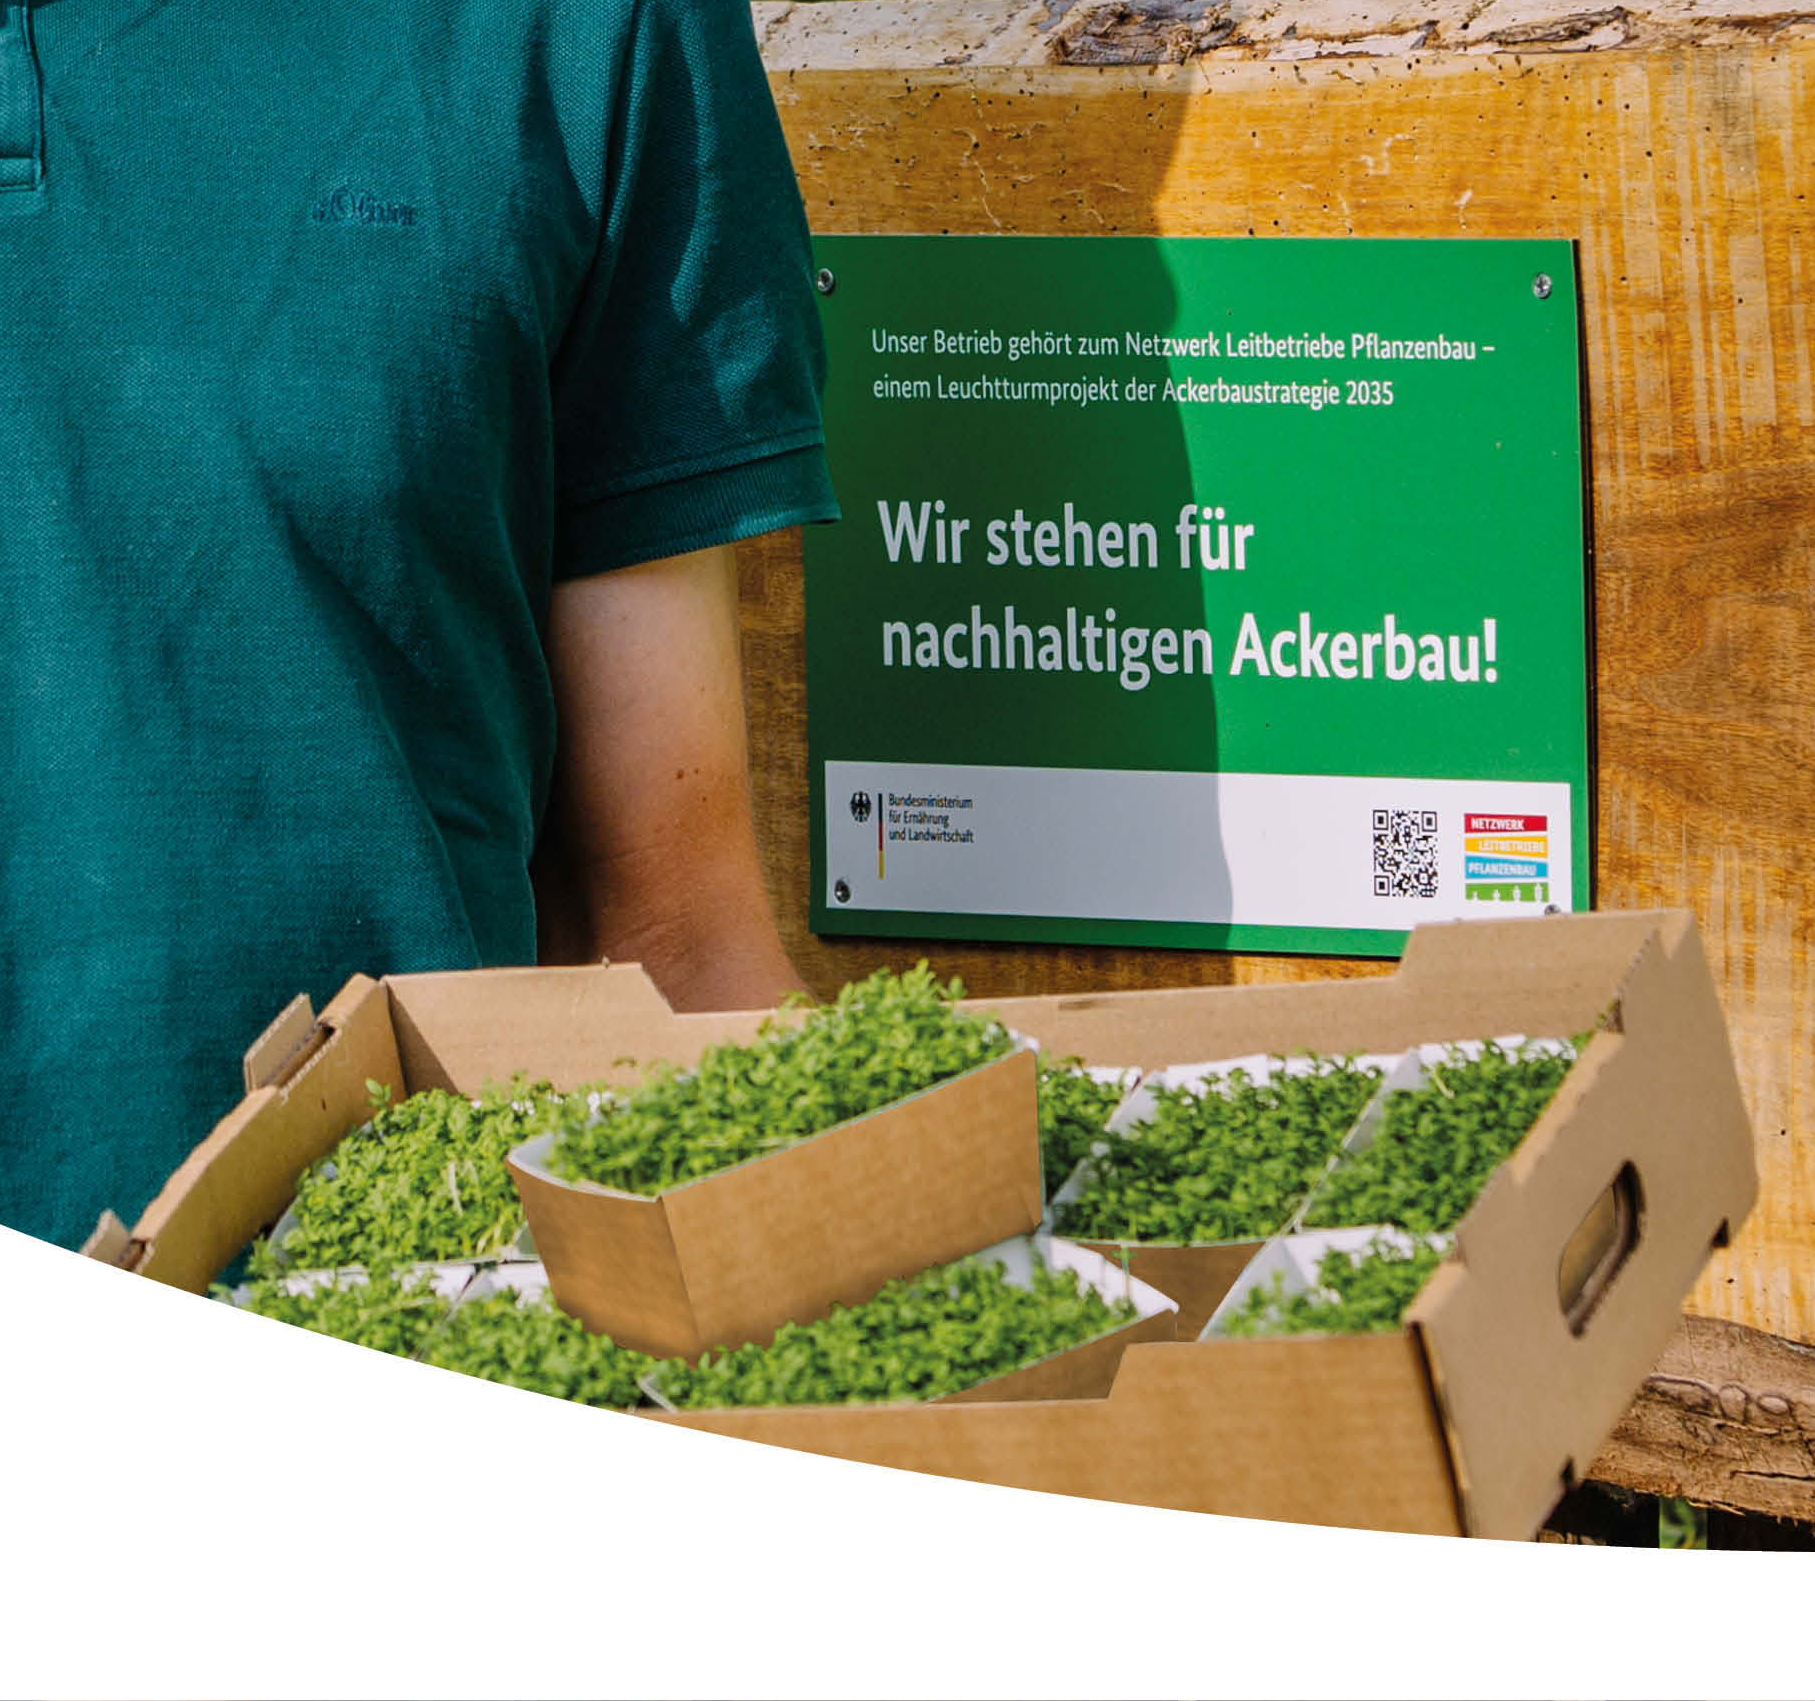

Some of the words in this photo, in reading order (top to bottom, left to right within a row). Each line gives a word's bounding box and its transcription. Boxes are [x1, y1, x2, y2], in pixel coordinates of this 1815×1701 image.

[872, 328, 927, 353] Unser
[934, 329, 1002, 355] Betrieb
[1008, 330, 1072, 361] gehört
[1078, 336, 1119, 356] zum
[1126, 331, 1220, 358] Netzwerk
[1226, 332, 1345, 359] Leitbetriebe
[1351, 333, 1476, 361] Pflanzenbau
[873, 373, 930, 399] einem
[937, 374, 1119, 407] Leuchtturmprojekt
[1125, 377, 1156, 402] der
[1162, 376, 1340, 411] Ackerbaustrategie
[1346, 380, 1394, 406] 2035
[877, 499, 970, 565] Wir
[986, 504, 1159, 570] stehen
[1176, 505, 1255, 572] für
[883, 603, 1213, 691] nachhaltigen
[1229, 612, 1498, 684] Ackerbau!
[889, 793, 973, 809] Bundesministerium
[889, 810, 901, 824] für
[904, 810, 950, 828] Ernährung
[1471, 817, 1525, 830] NETZWERK
[889, 828, 906, 841] und
[908, 828, 974, 843] Landwirtschaft
